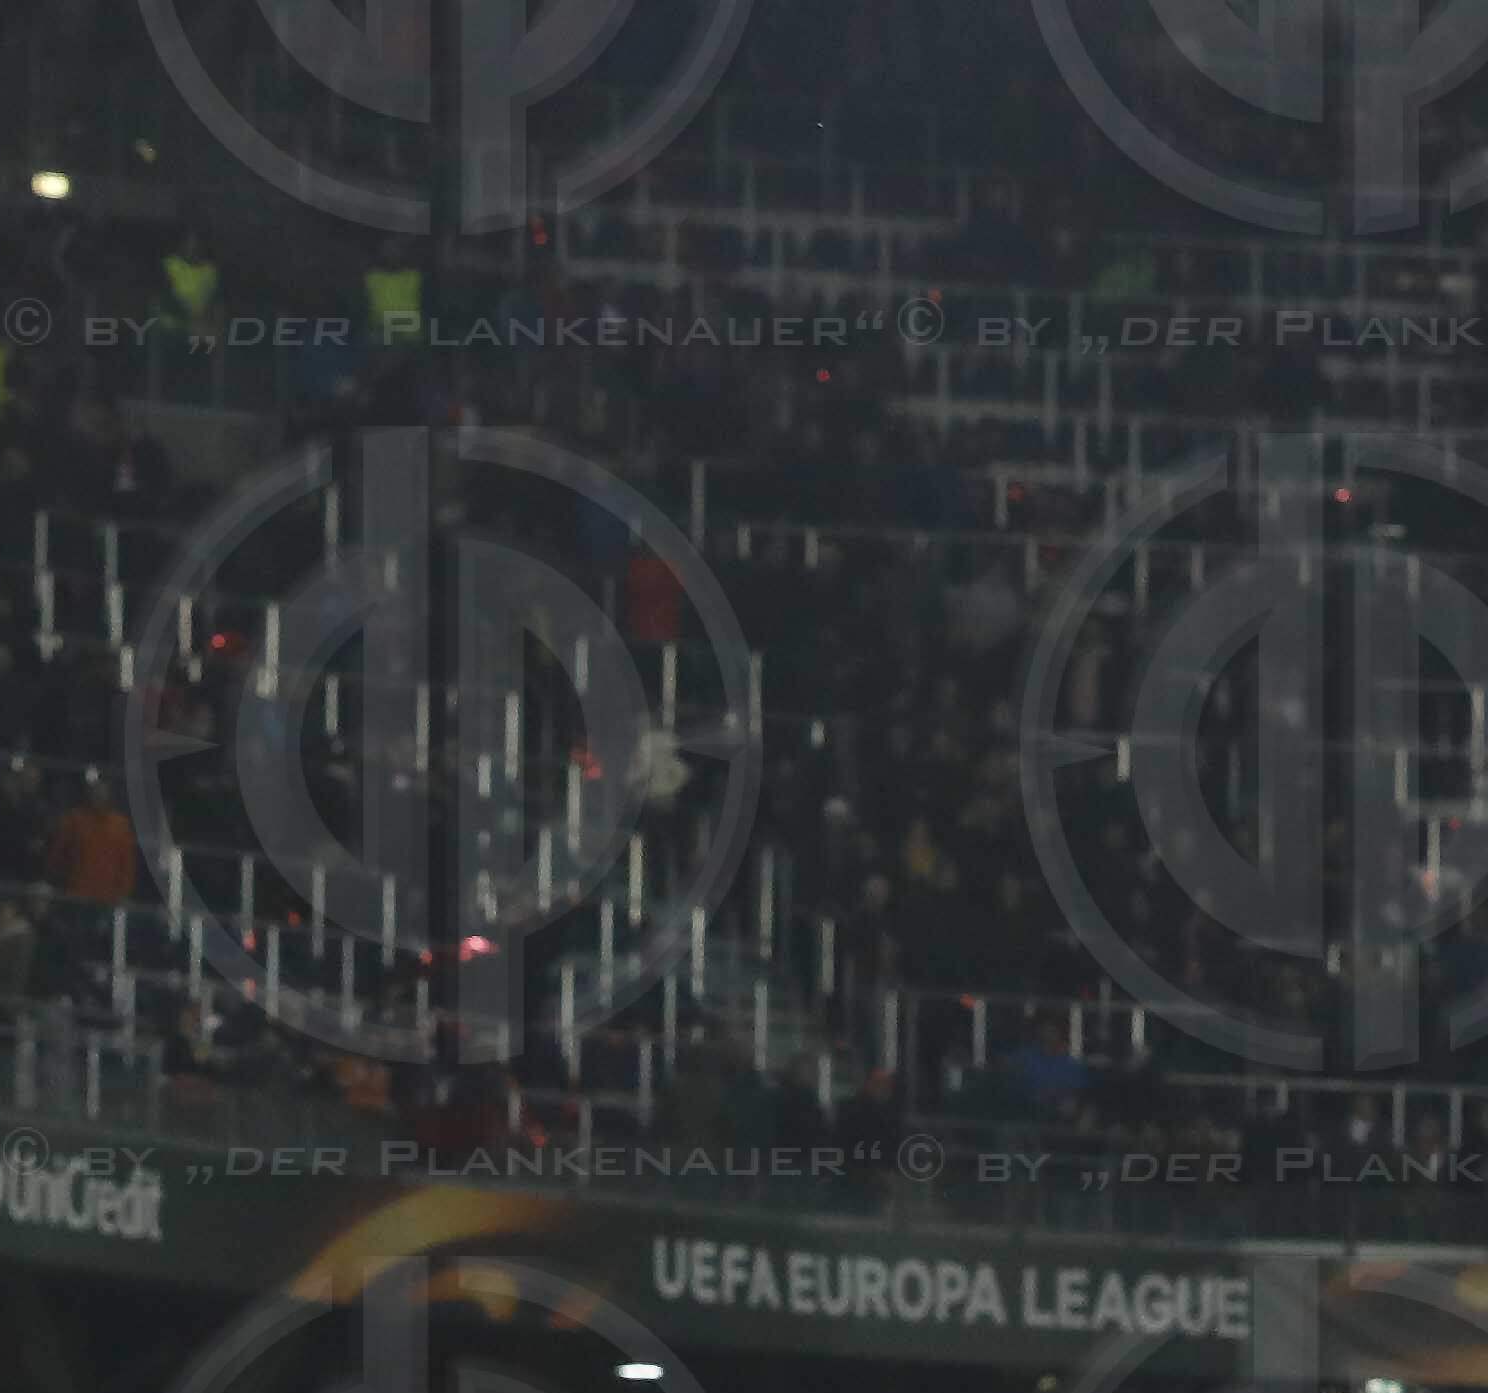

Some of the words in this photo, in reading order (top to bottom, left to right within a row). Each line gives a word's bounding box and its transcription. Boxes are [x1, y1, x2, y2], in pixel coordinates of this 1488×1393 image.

[651, 1238, 781, 1313] UEFA
[786, 1253, 1009, 1327] EUROPA
[1022, 1266, 1251, 1342] LEAGUE
